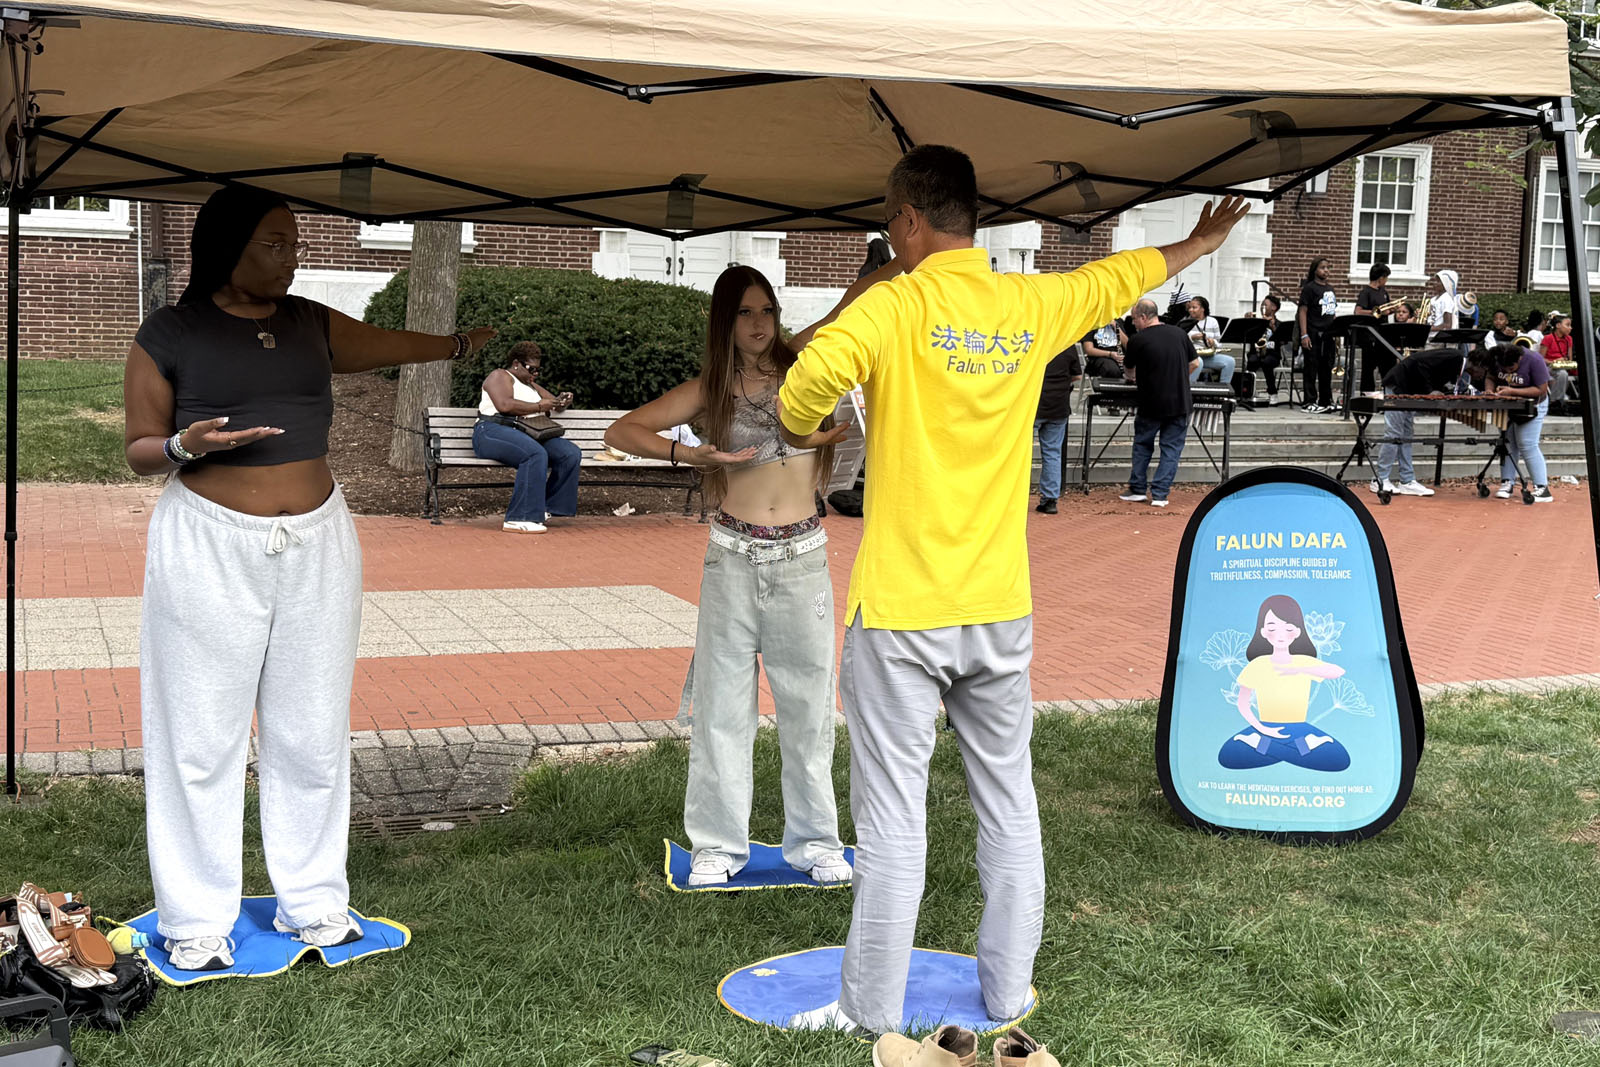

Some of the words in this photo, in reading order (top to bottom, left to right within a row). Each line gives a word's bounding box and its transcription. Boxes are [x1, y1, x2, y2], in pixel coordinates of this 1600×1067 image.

[930, 324, 1035, 356] 法輪大法
[946, 355, 986, 375] Falun
[991, 358, 1021, 375] Daf
[1216, 532, 1283, 551] FALUN
[1291, 532, 1347, 549] DAFA
[1223, 560, 1228, 569] A
[1229, 559, 1263, 569] SPIRITUAL
[1264, 558, 1301, 568] DISCIPLINE
[1302, 558, 1327, 568] GUIDED
[1328, 558, 1338, 568] BY
[1210, 571, 1264, 581] TRUTHFULNESS,
[1264, 569, 1310, 580] COMPASSION,
[1311, 570, 1352, 580] TOLERANCE
[1198, 781, 1209, 790] ASK
[1210, 782, 1217, 790] TO
[1218, 782, 1236, 791] LEARN
[1236, 783, 1247, 791] THE
[1247, 784, 1280, 793] MEDITATION
[1312, 785, 1321, 793] OR
[1321, 785, 1335, 793] FIND
[1335, 785, 1347, 794] OUT
[1347, 785, 1364, 793] MORE
[1225, 793, 1346, 808] FALUNDAFA.ORG
